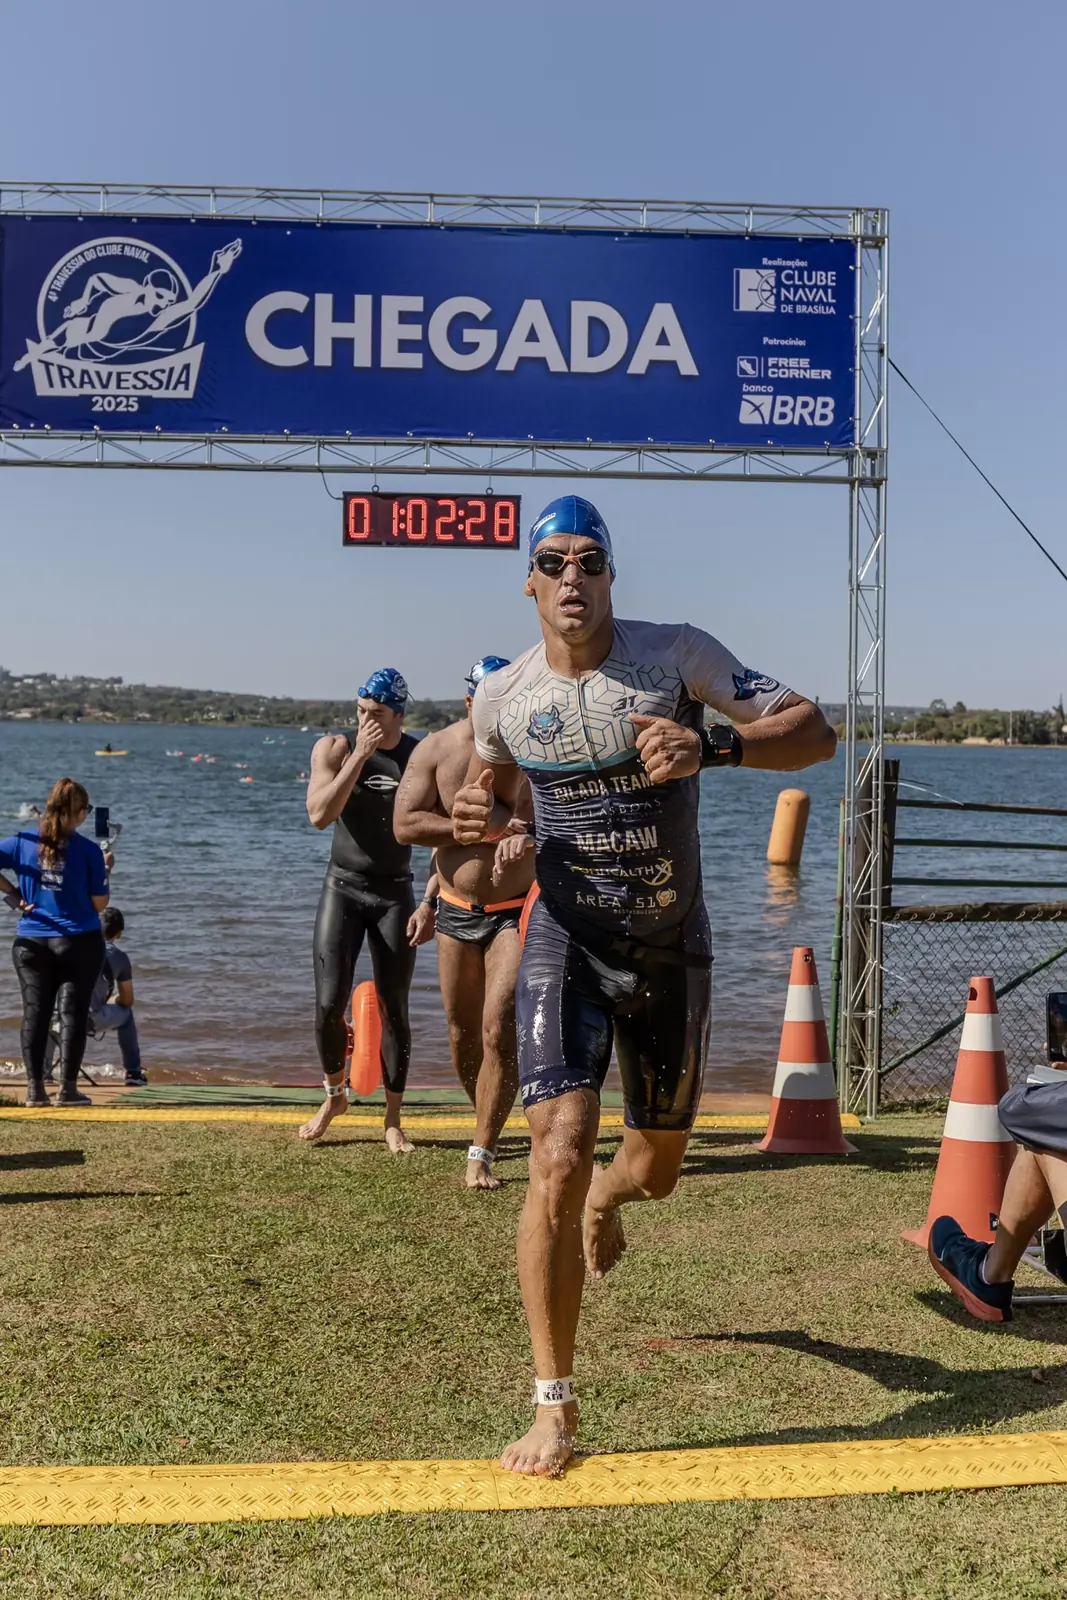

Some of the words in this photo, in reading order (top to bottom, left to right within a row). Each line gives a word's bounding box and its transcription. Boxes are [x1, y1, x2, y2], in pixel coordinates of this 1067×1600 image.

[51, 254, 86, 291] TRAVESSIA
[83, 249, 97, 262] DO
[96, 244, 123, 257] CLUBE
[123, 245, 151, 263] NAVAL
[762, 258, 808, 268] Realização:
[781, 270, 836, 286] CLUBE
[780, 287, 836, 303] NAVAL
[781, 304, 793, 313] DE
[795, 304, 836, 315] BRASÍLIA
[245, 291, 699, 376] CHEGADA
[763, 337, 806, 346] Patrocínio:
[768, 357, 810, 368] FREE
[37, 359, 191, 392] TRAVESSIA
[768, 368, 832, 379] CORNER
[742, 383, 774, 393] banco
[91, 396, 139, 412] 2025
[773, 395, 835, 427] BRB
[610, 771, 655, 794] TEAM
[576, 826, 658, 853] MACAW
[576, 891, 621, 908] ÁREA
[635, 896, 656, 909] 51
